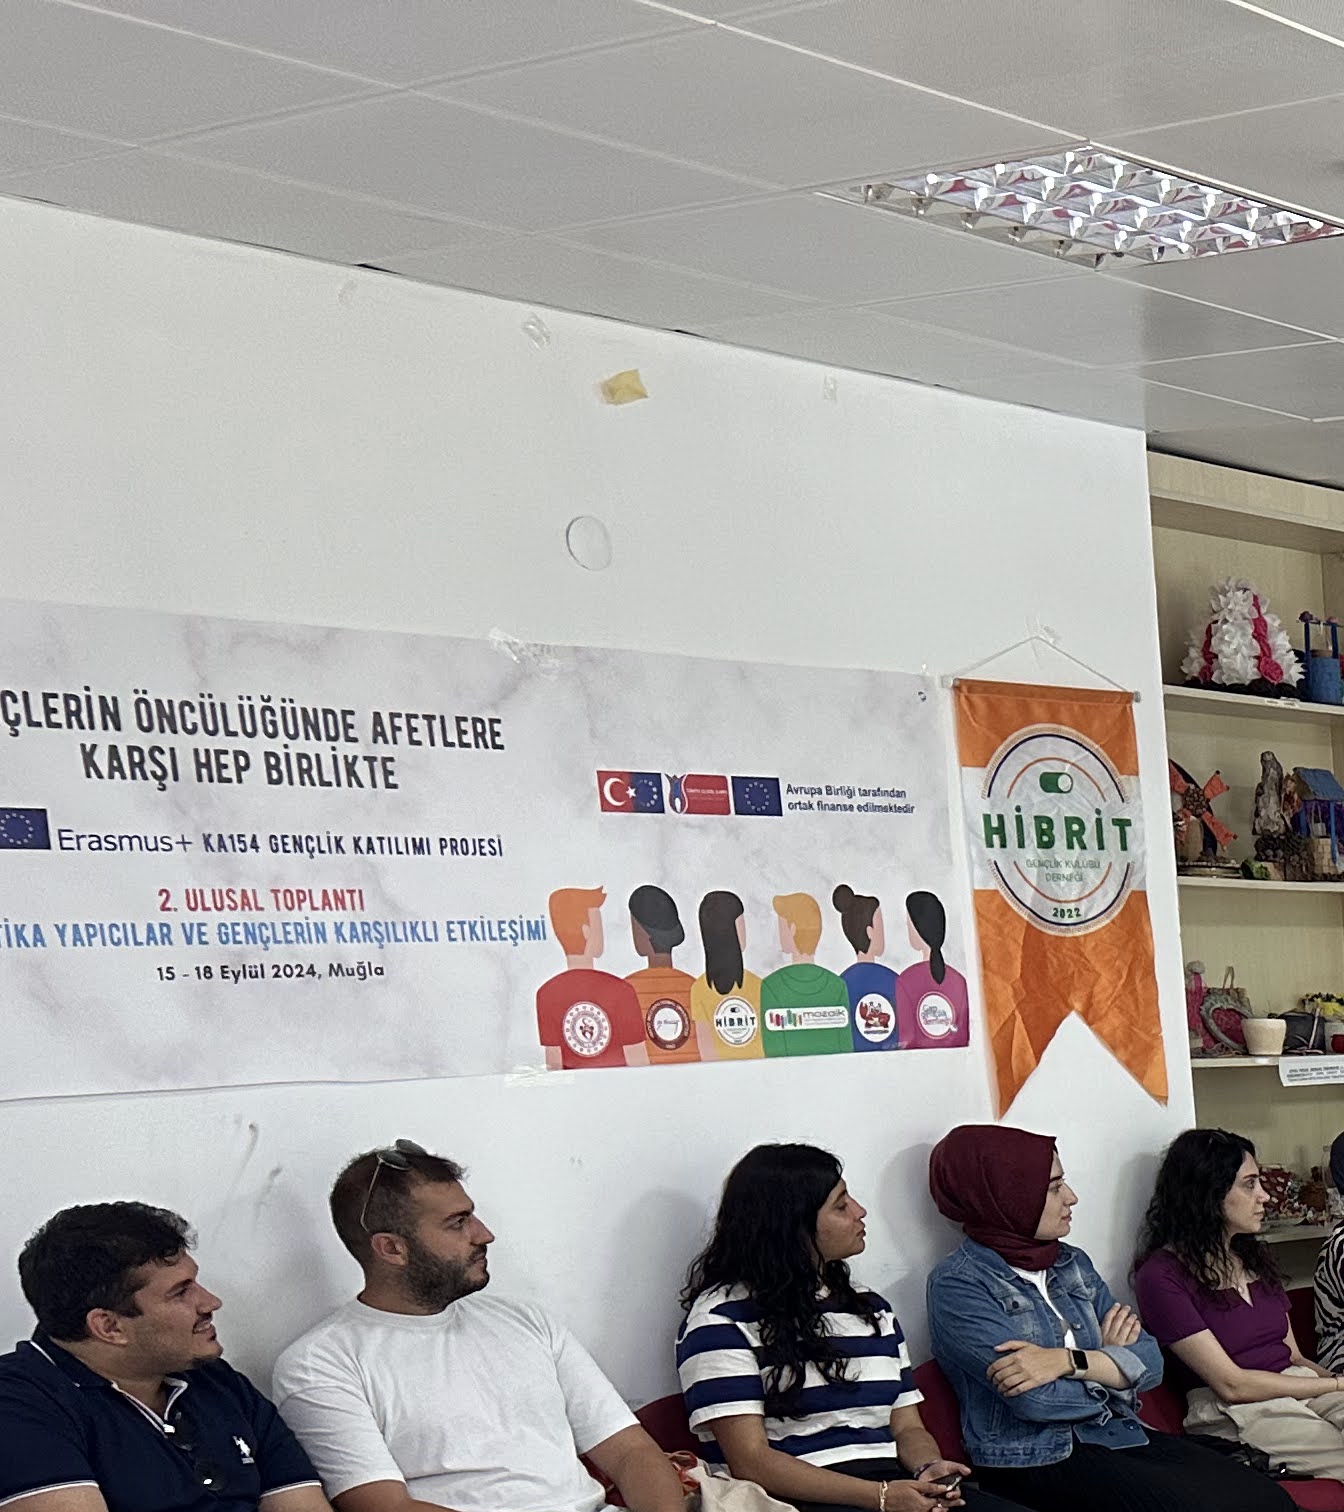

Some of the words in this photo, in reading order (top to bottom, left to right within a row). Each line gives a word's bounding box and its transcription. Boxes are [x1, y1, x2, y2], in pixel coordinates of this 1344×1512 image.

[0, 686, 121, 737] ÇLERİN
[133, 688, 358, 743] ÖNCÜLÜĞÜNDE
[372, 711, 505, 750] AFETLERE
[80, 743, 179, 791] KARŞI
[193, 748, 250, 784] HEP
[264, 743, 399, 790] BİRLİKTE
[786, 784, 823, 797] Avrupa
[825, 785, 856, 799] Birliği
[858, 787, 906, 799] tarafından
[787, 801, 814, 812] ortak
[817, 800, 854, 812] finanse
[982, 805, 1132, 851] HİBRİT
[57, 829, 193, 852] Erasmus+
[202, 833, 260, 853] KA154
[269, 831, 344, 859] GENÇLİK
[353, 836, 431, 855] KATILIMI
[440, 834, 503, 857] PROJESİ
[158, 889, 178, 912] 2.
[185, 889, 265, 911] ULUSAL
[271, 889, 364, 912] TOPLANTI
[1053, 907, 1082, 919] 2022
[54, 922, 174, 947] YAPICILAR
[181, 922, 209, 945] VE
[216, 916, 328, 951] GENÇLERİN
[334, 920, 439, 949] KARŞILIKLI
[446, 914, 547, 946] ETKİLEŞİMİ
[157, 966, 176, 981] 15
[195, 965, 213, 981] 18
[221, 963, 265, 984] Eylül
[271, 963, 322, 980] 2024,
[328, 961, 385, 981] Muğla
[802, 1009, 846, 1018] mozaik
